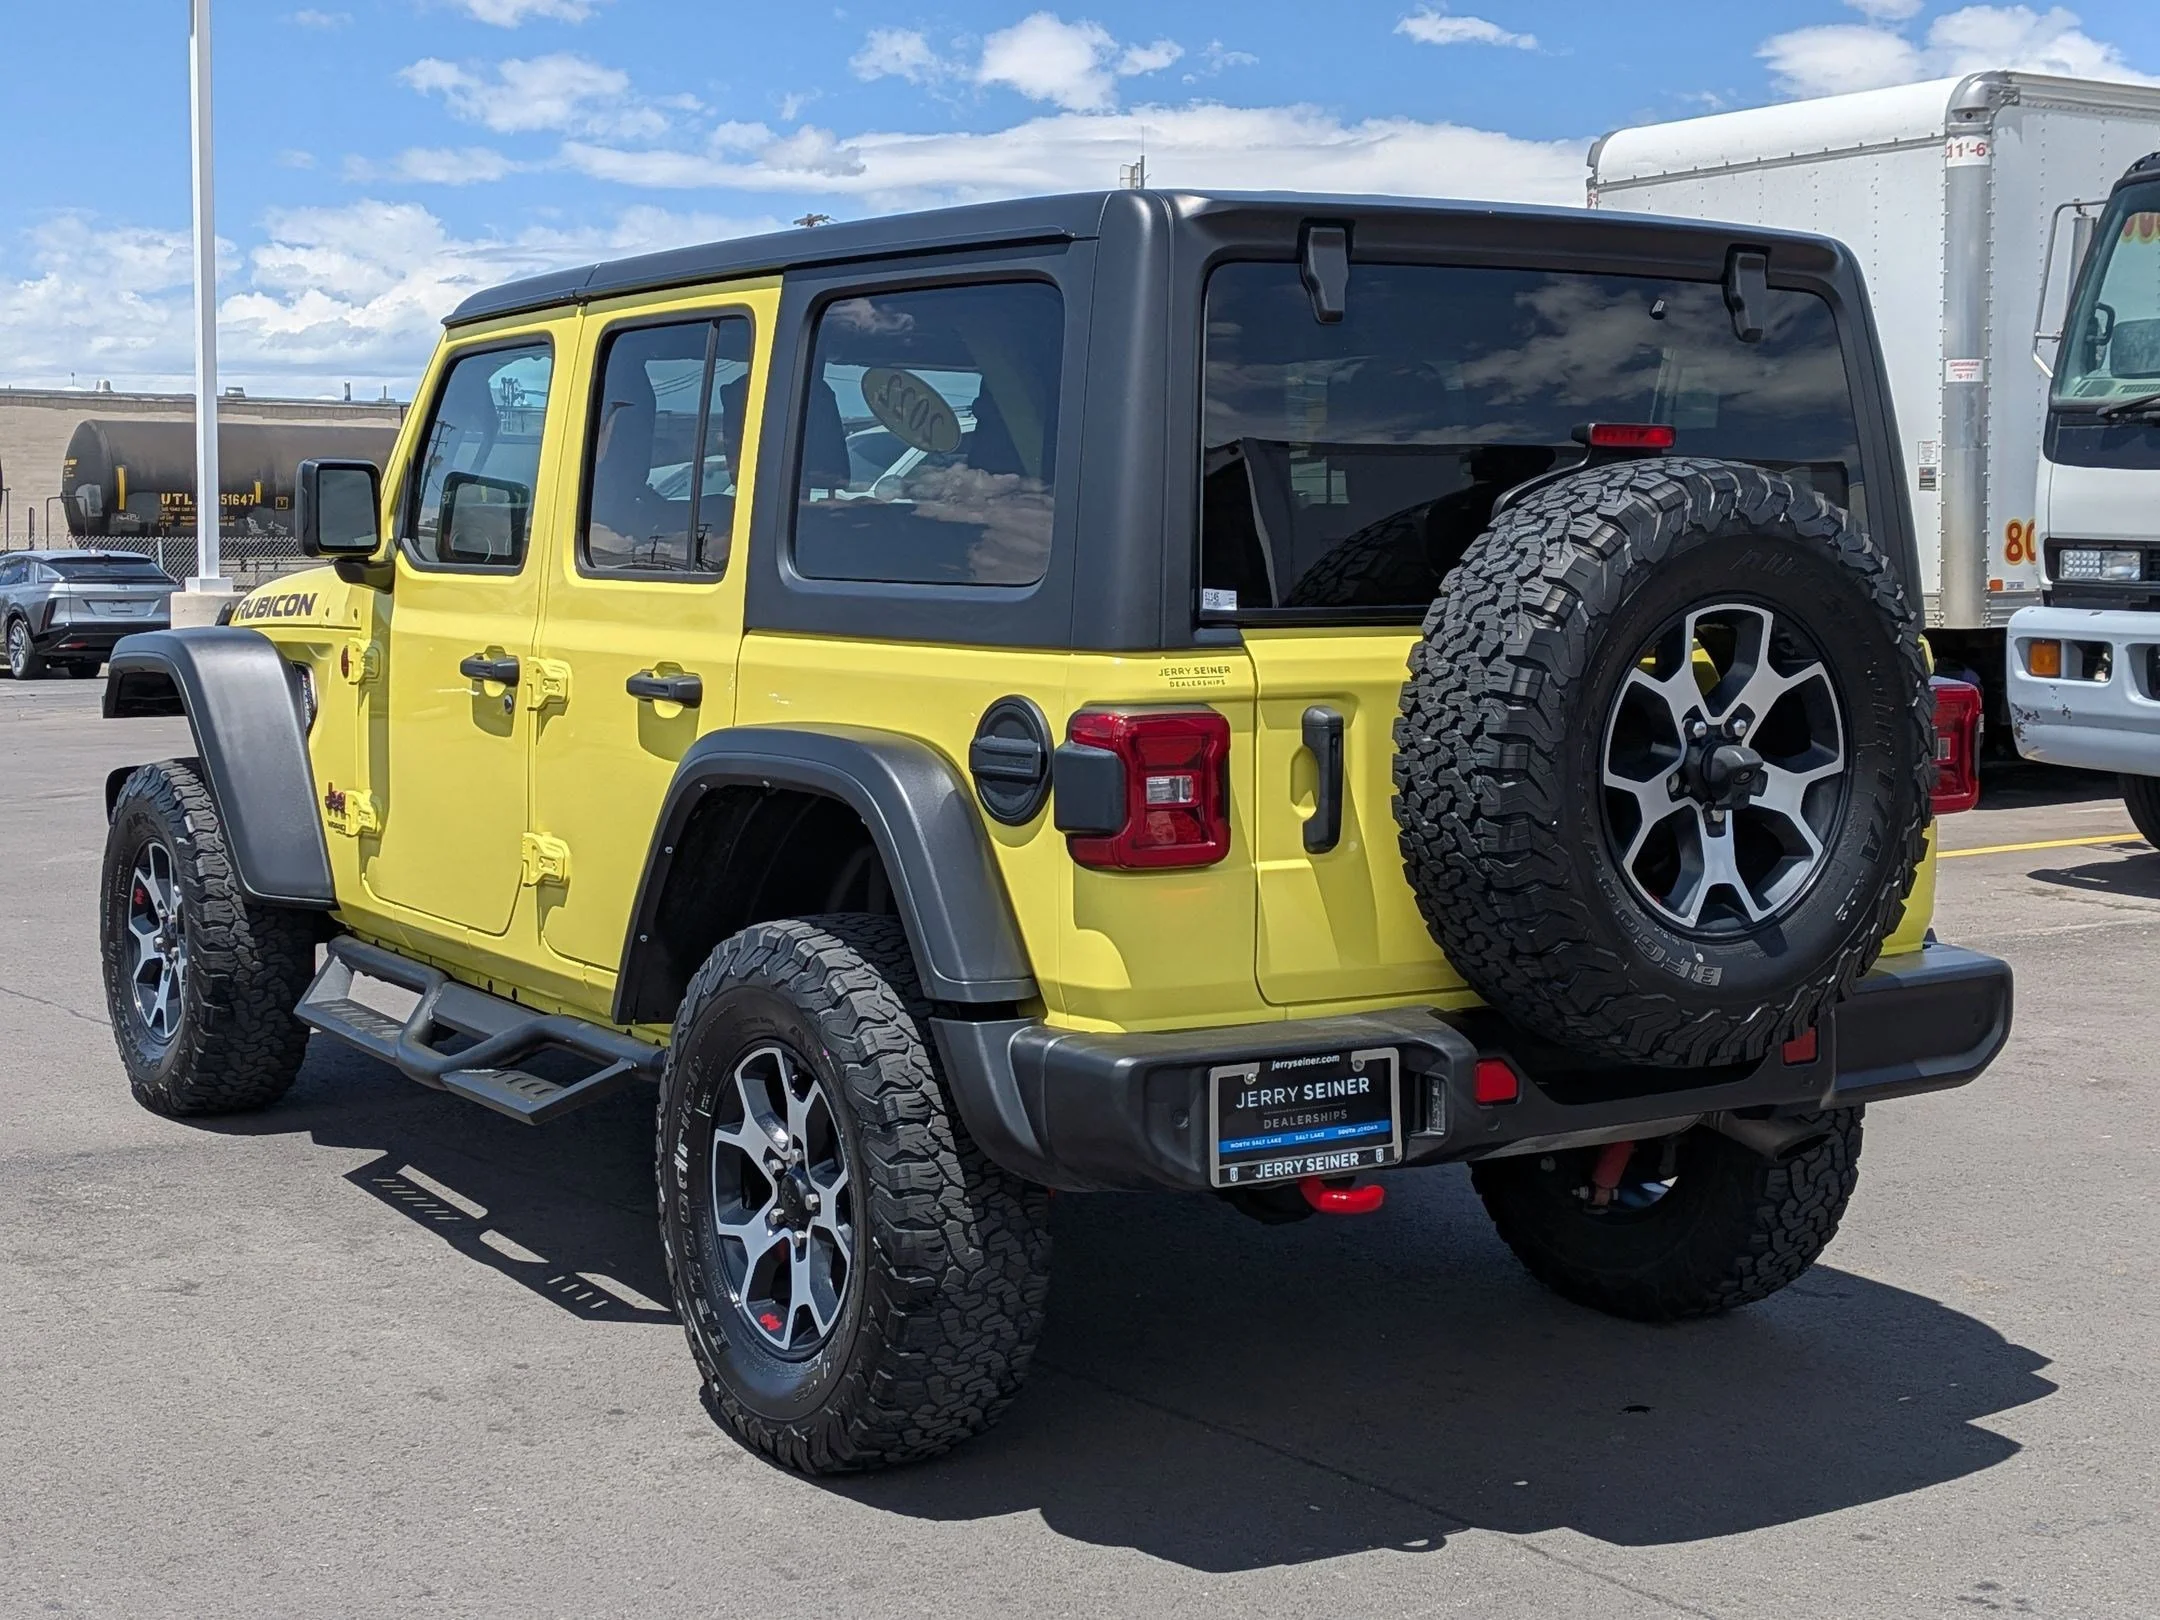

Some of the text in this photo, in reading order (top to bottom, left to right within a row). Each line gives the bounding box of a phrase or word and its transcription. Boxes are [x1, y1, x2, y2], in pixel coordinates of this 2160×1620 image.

[234, 593, 318, 621] RUBICON
[1158, 665, 1231, 677] JERRY SEINER
[1169, 679, 1226, 688] DEALERSHIPS
[1271, 1053, 1340, 1072] jerryseiner.com
[1235, 1077, 1370, 1109] JERRY SEINER
[1263, 1109, 1348, 1130] DEALERSHIPS
[1230, 1124, 1379, 1149] NORTH SALT LAKE SALT LAKE SOUTH JORDAN
[1255, 1152, 1359, 1179] JERRY SEINER
